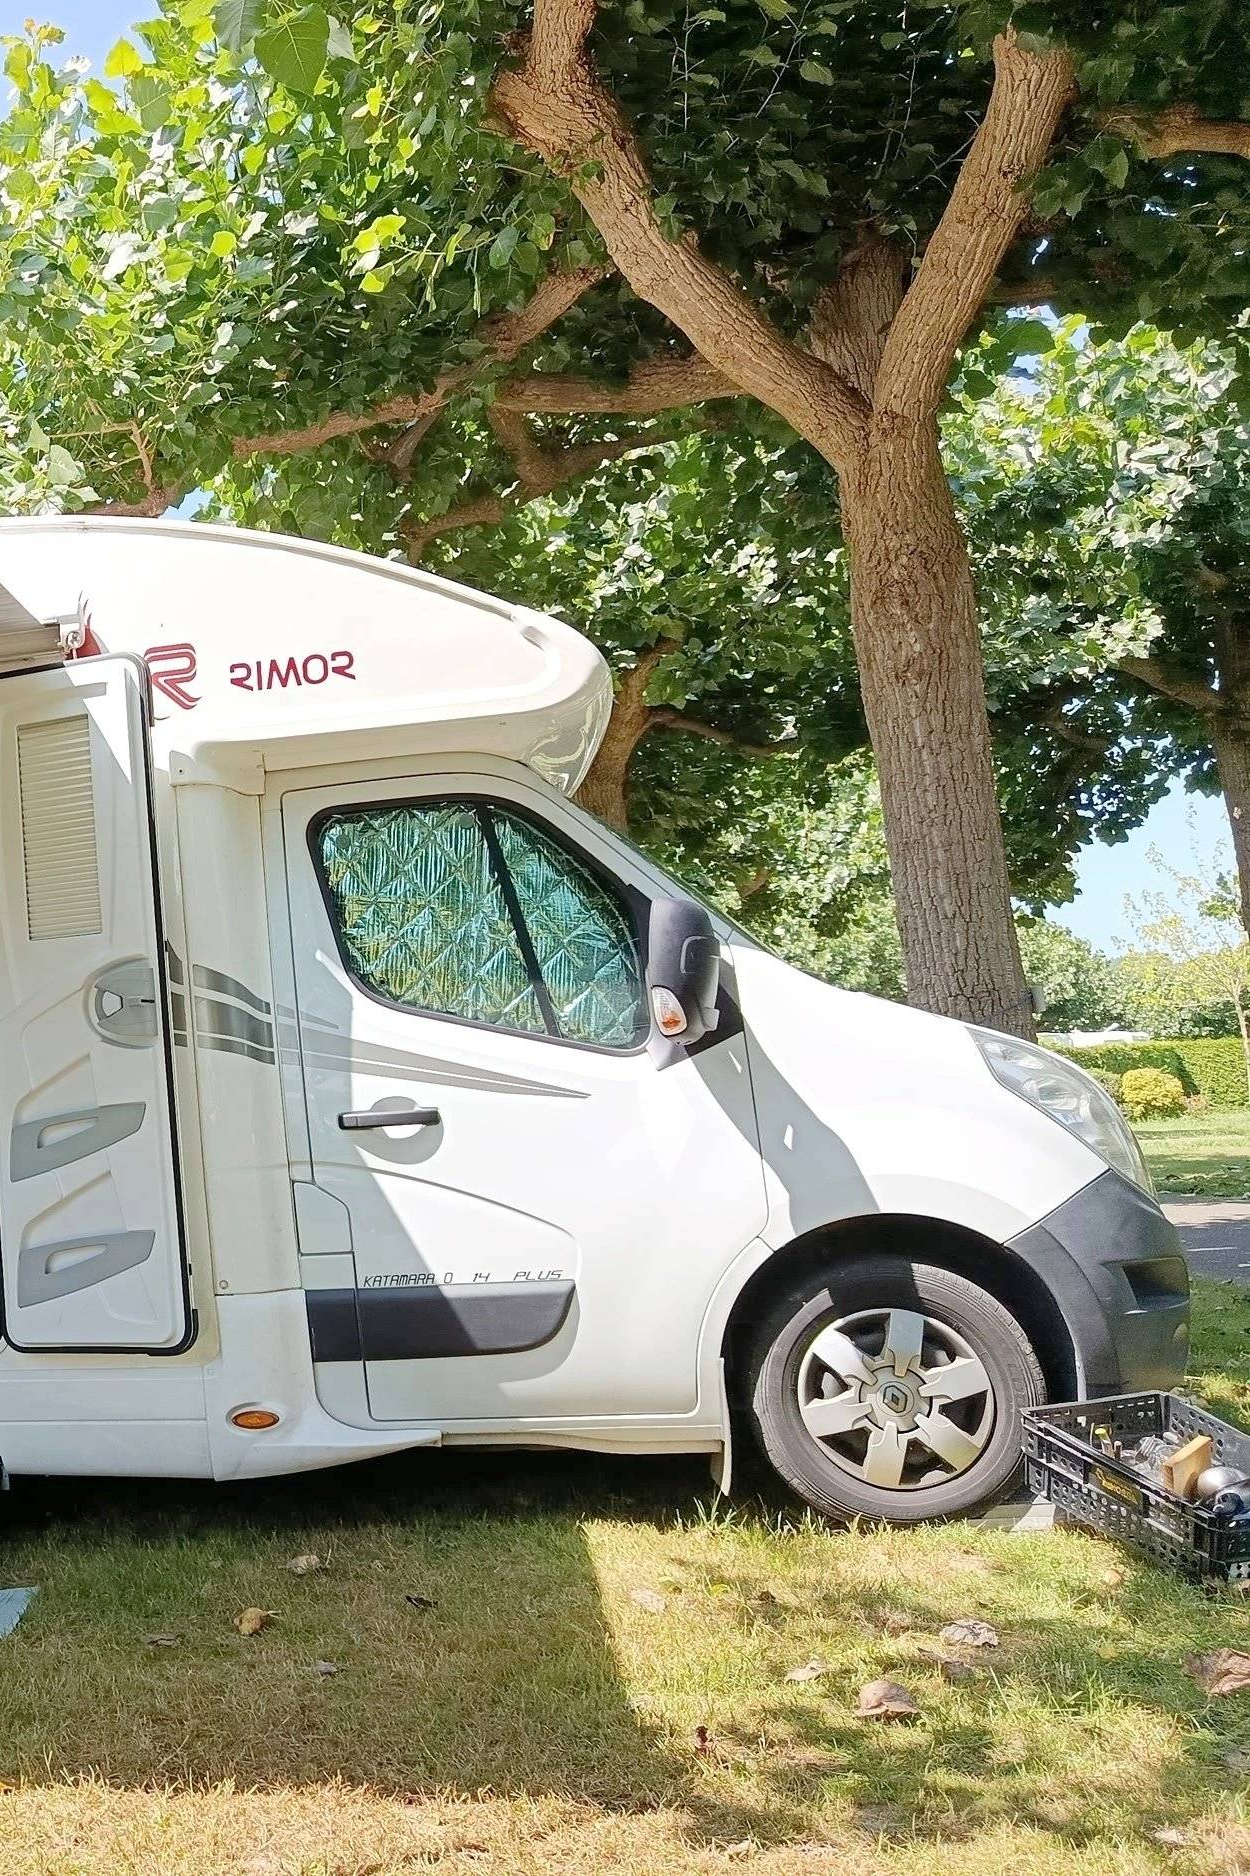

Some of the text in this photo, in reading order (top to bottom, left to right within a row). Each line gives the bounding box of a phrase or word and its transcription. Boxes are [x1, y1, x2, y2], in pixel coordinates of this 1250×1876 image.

[229, 650, 356, 692] RIMOR
[472, 1272, 491, 1283] 14
[513, 1269, 564, 1281] PLUS
